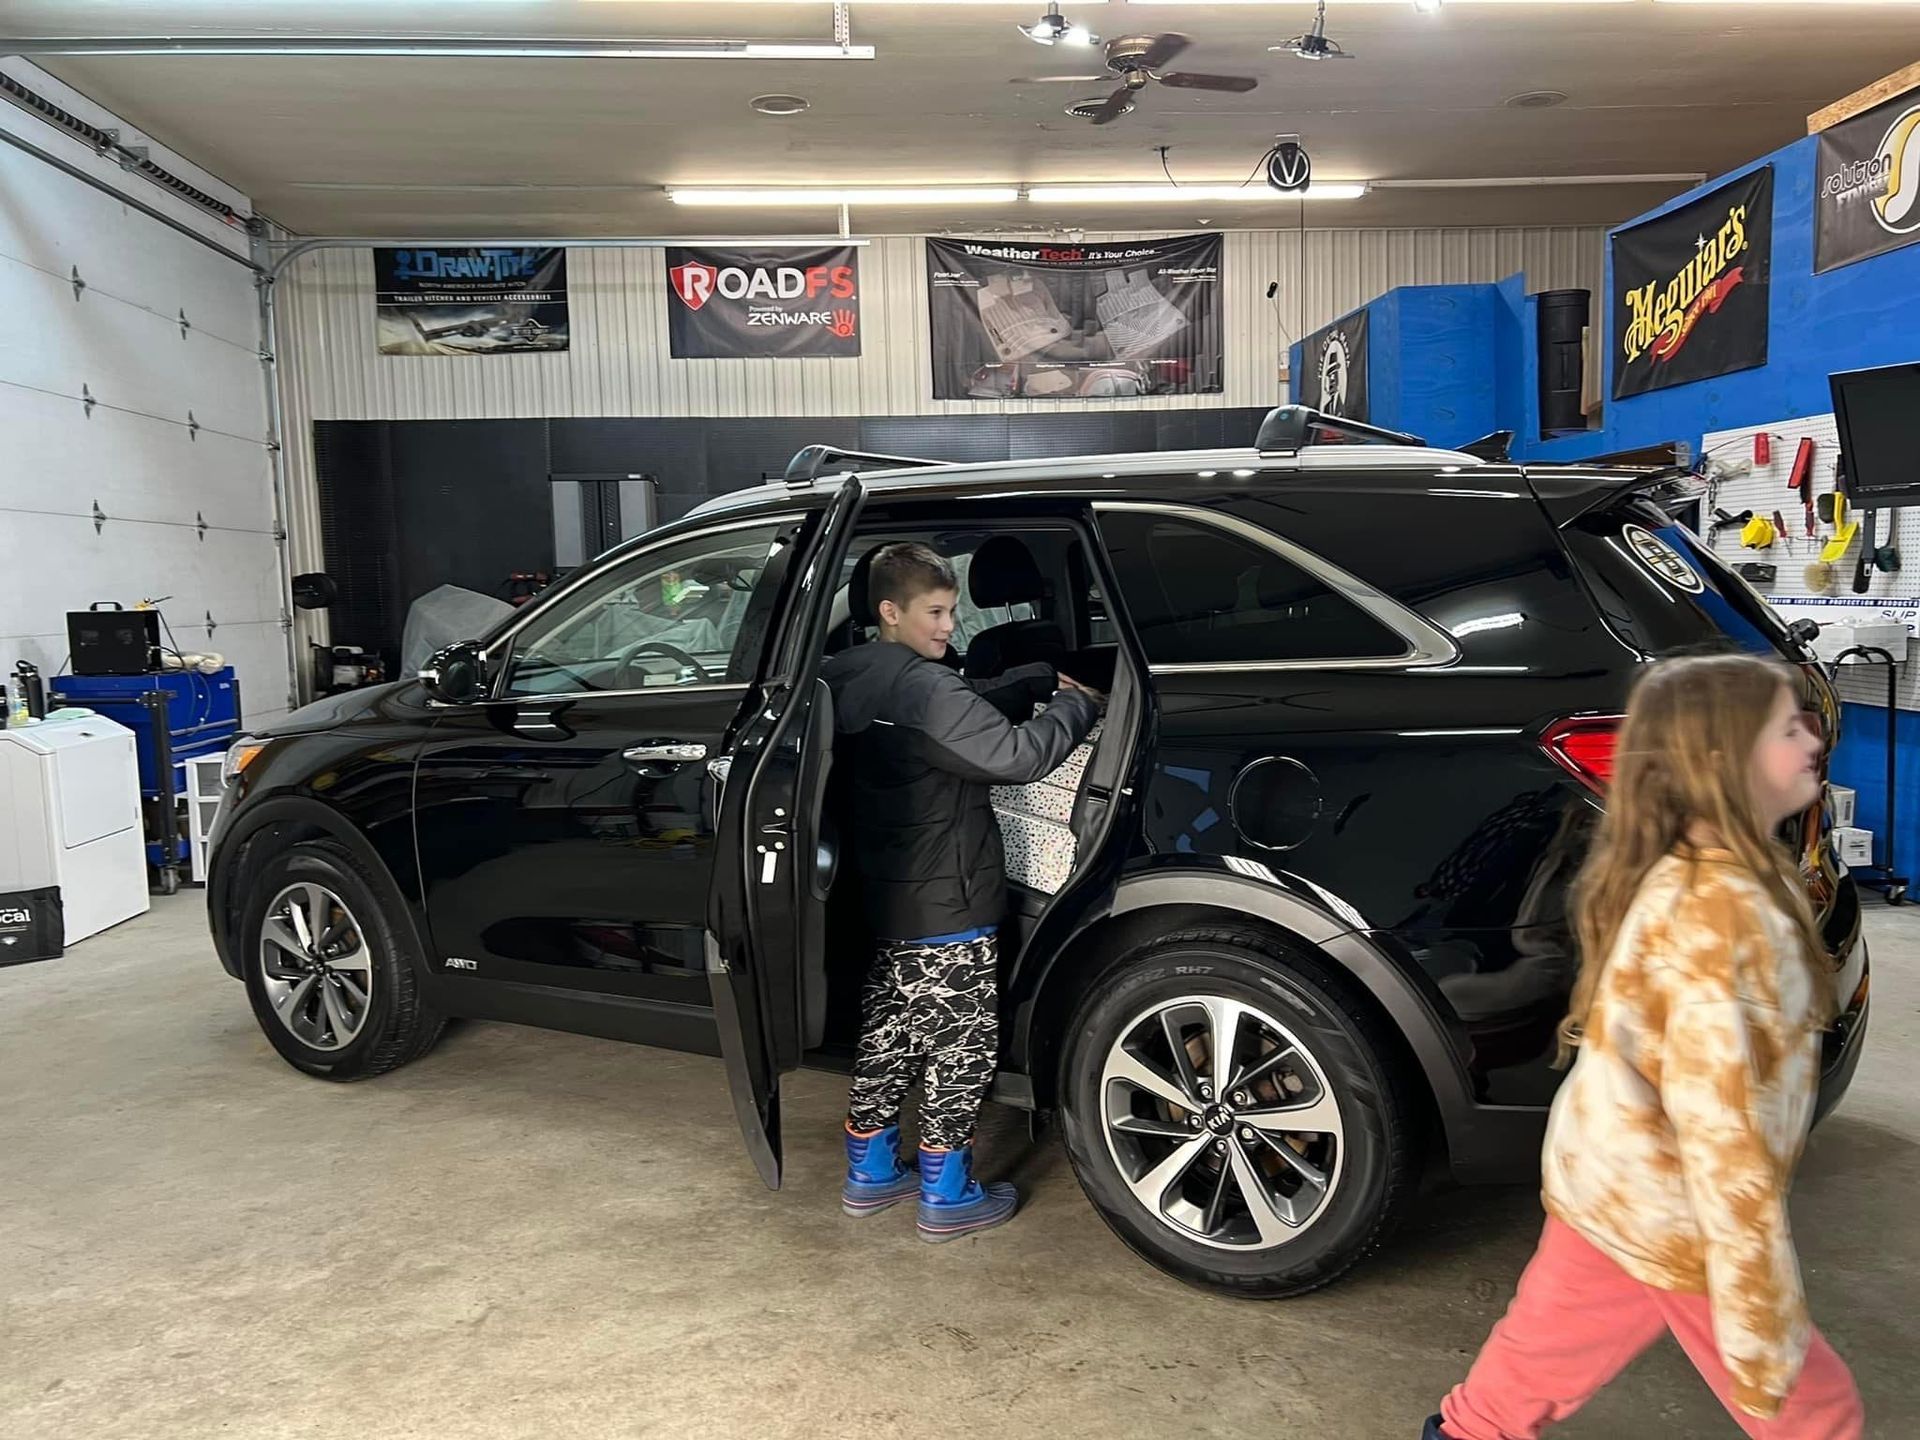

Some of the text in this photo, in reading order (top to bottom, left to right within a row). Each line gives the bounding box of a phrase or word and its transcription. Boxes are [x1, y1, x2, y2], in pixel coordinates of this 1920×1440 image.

[964, 245, 1082, 261] WeatherTech
[1088, 251, 1102, 260] It's
[1104, 251, 1123, 259] Your
[1624, 205, 1747, 363] Meguiar's
[747, 312, 832, 326] ZENWARE
[0, 909, 31, 924] cal
[1207, 1112, 1231, 1130] KIA
